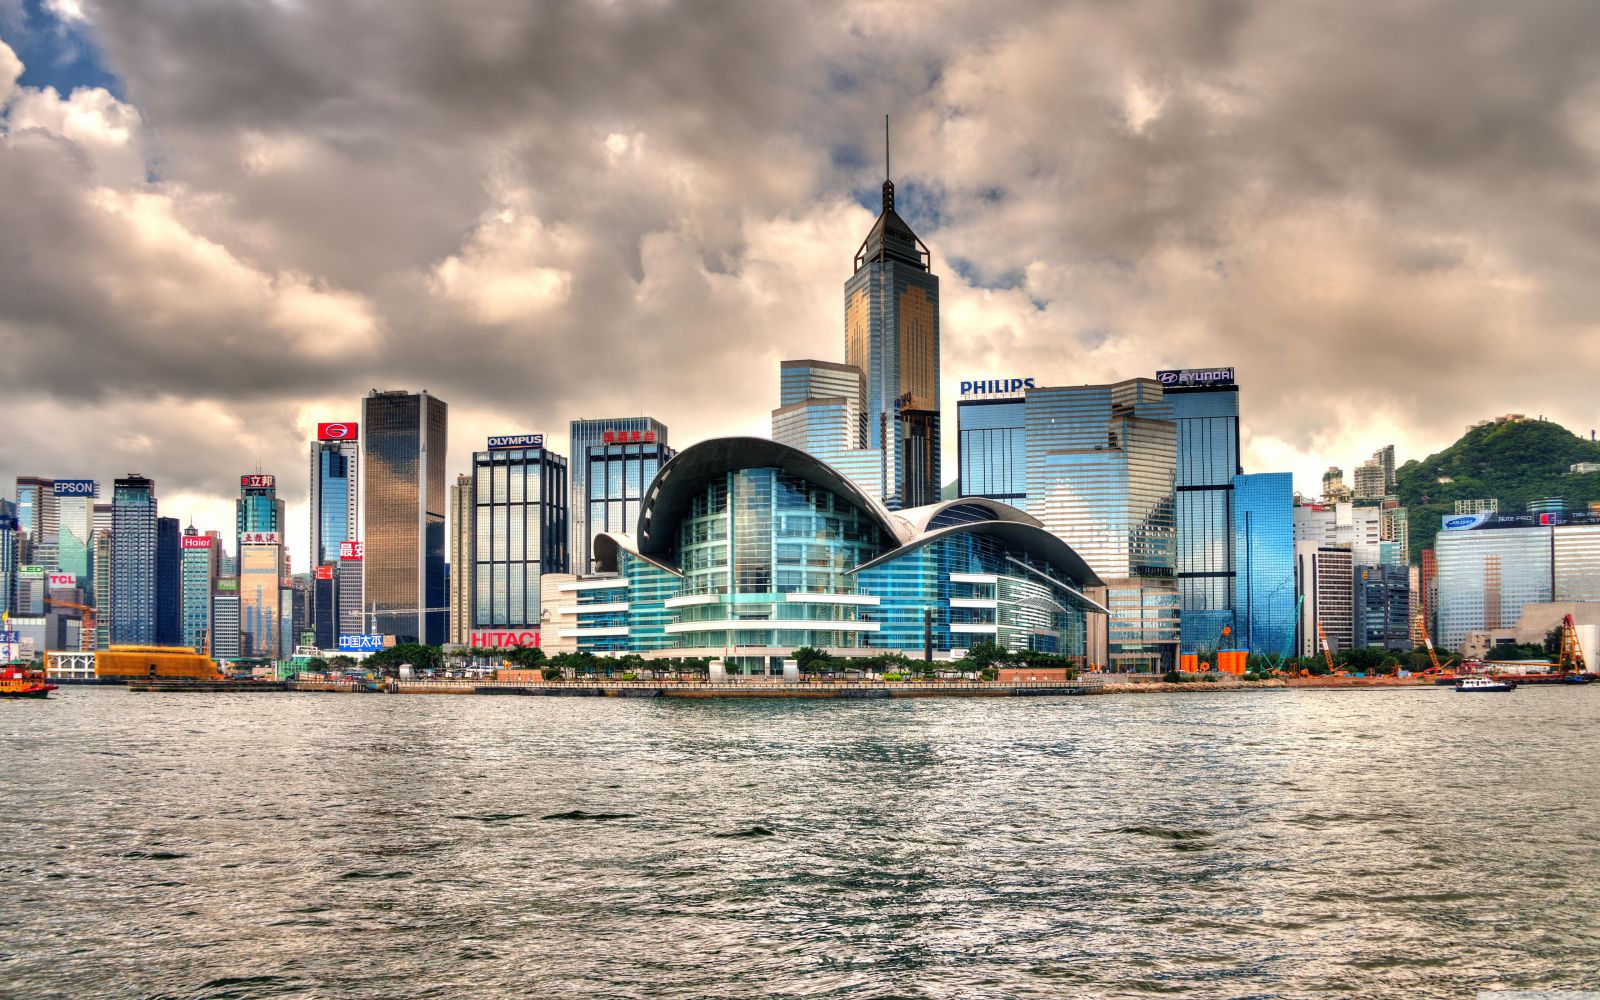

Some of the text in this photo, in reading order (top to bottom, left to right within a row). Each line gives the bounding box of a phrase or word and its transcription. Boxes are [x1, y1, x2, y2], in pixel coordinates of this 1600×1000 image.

[1179, 371, 1233, 381] HYUNDAI
[960, 378, 1034, 394] PHILIPS
[488, 436, 542, 445] OLYMPUS
[250, 476, 273, 486] 立邦
[54, 483, 93, 492] EPSON
[185, 538, 210, 547] Haier
[51, 575, 75, 584] TCL
[339, 635, 382, 648] 中国太平
